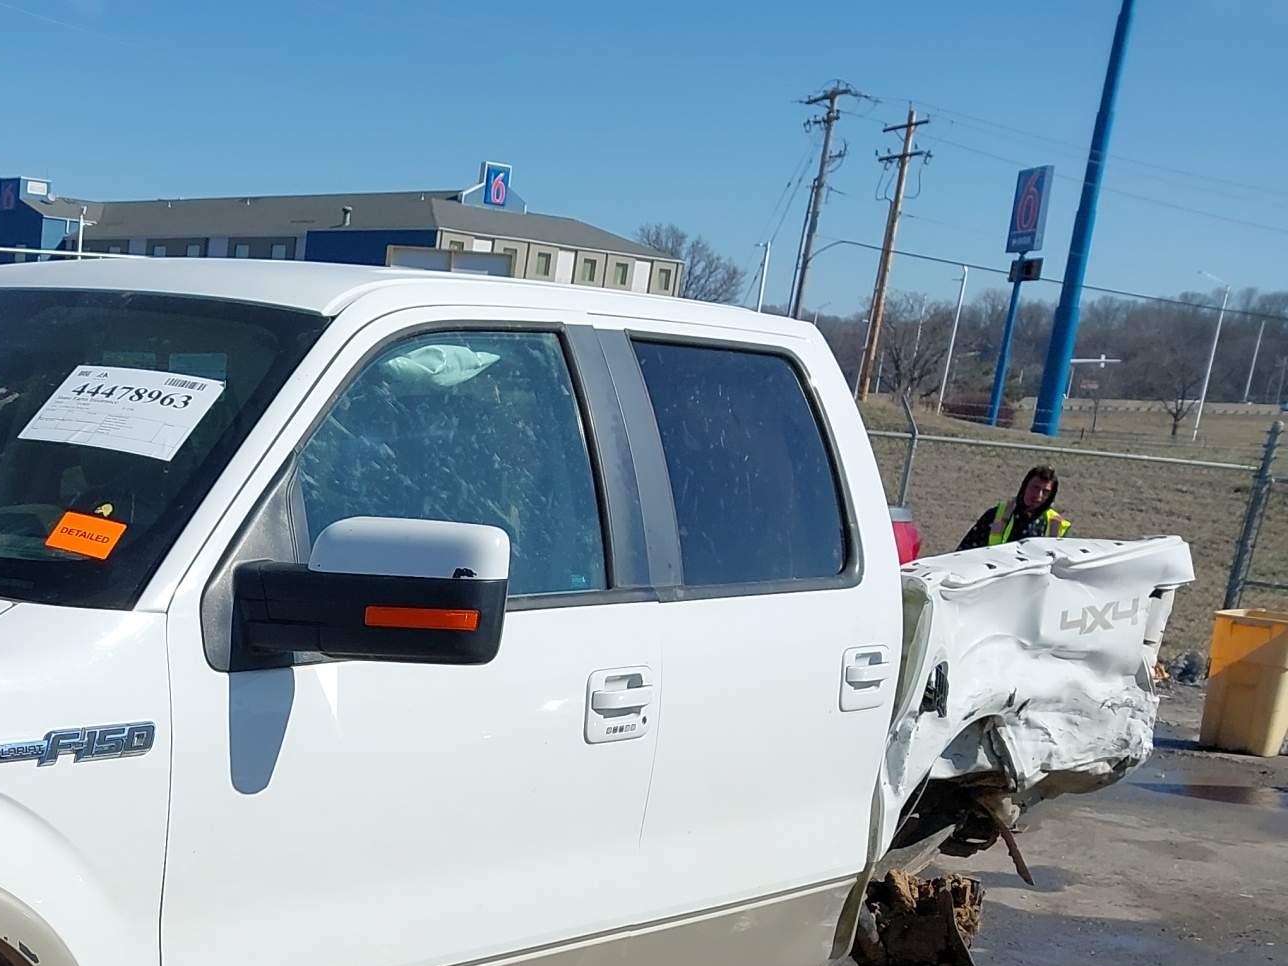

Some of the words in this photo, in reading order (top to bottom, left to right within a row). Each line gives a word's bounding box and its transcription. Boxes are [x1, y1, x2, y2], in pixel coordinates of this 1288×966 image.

[492, 172, 506, 205] 6
[1017, 173, 1039, 232] 6
[71, 382, 193, 410] 44478963
[59, 525, 111, 545] DETAILED
